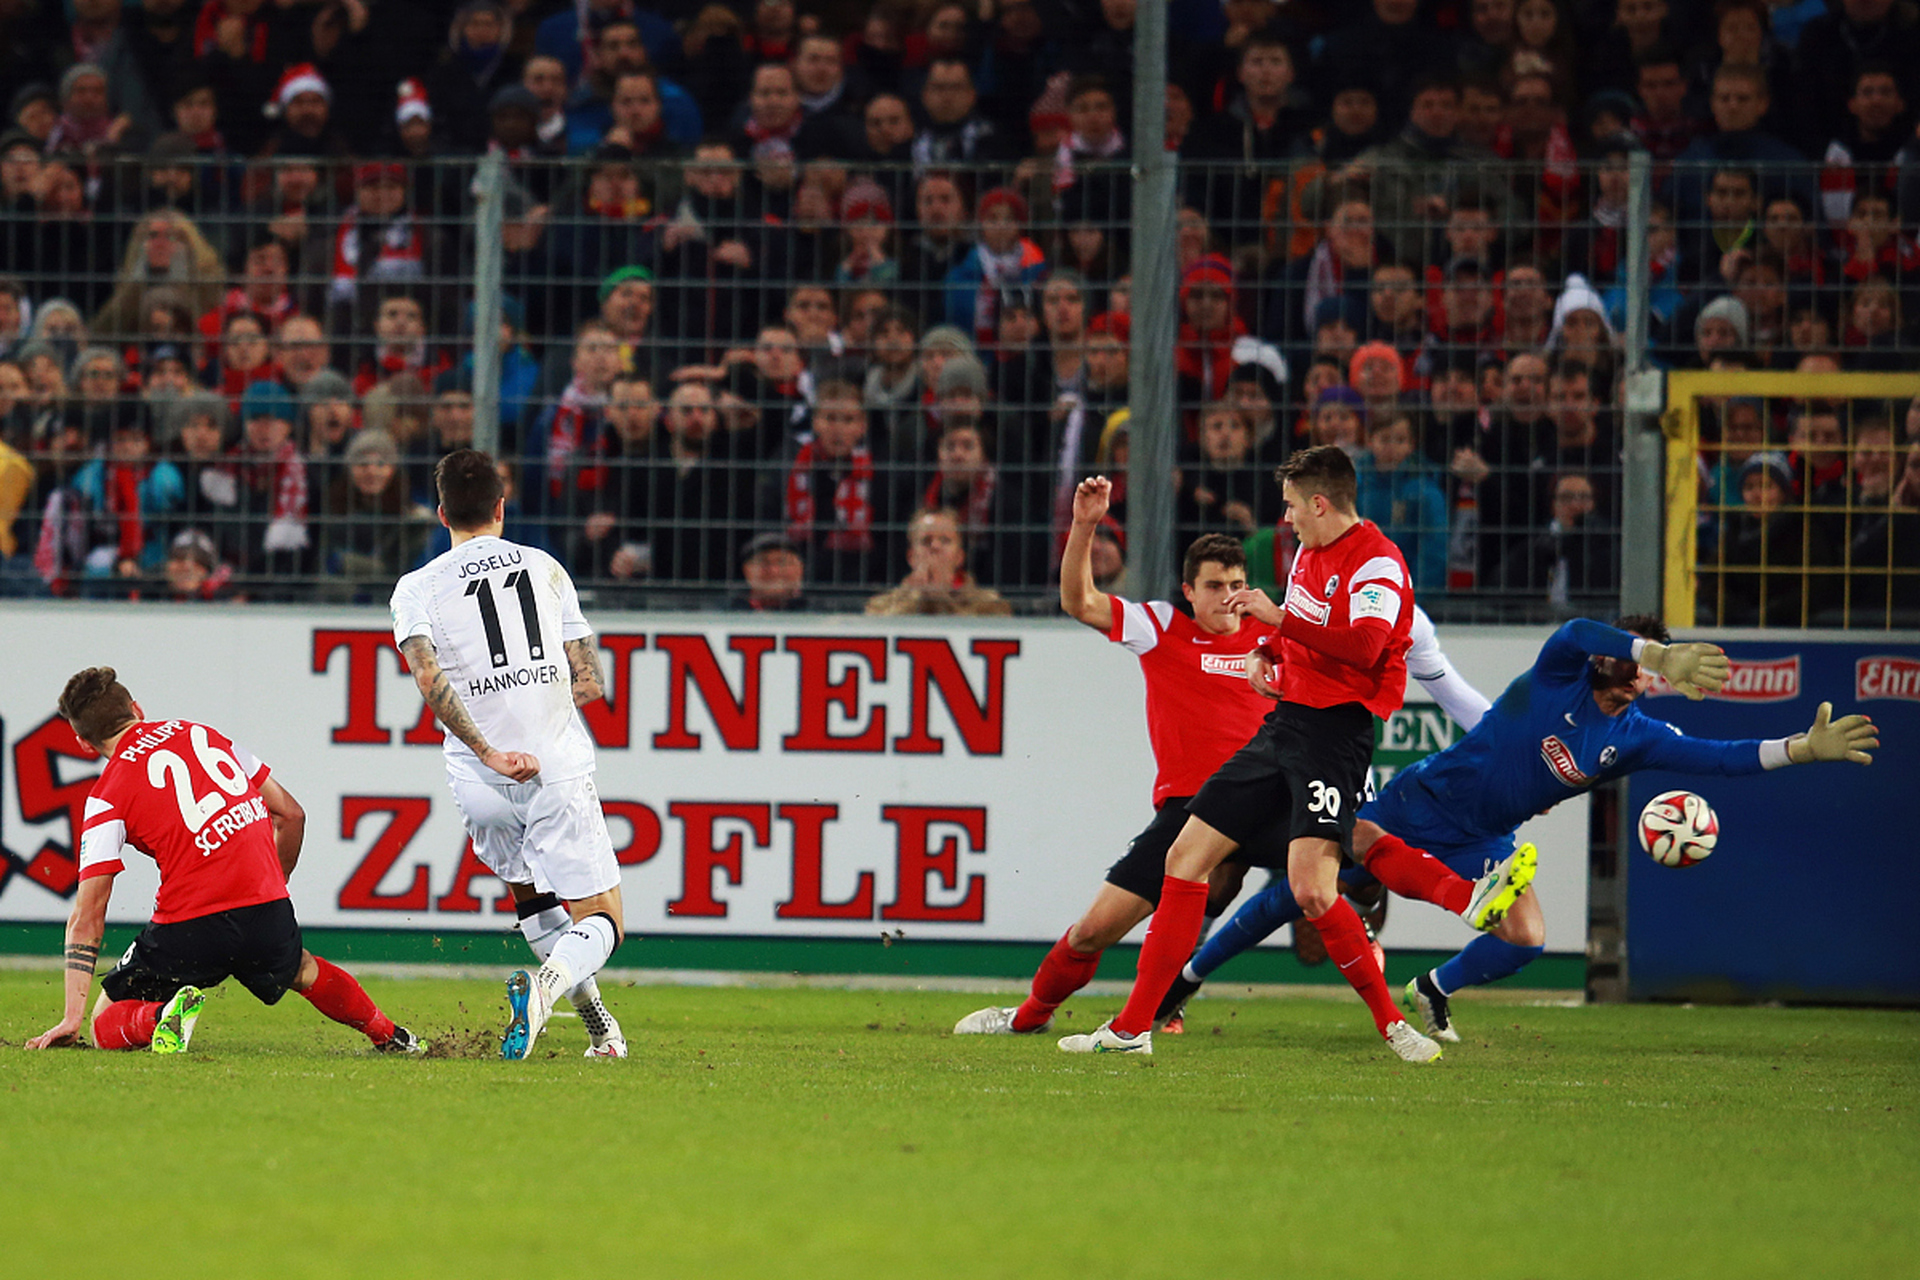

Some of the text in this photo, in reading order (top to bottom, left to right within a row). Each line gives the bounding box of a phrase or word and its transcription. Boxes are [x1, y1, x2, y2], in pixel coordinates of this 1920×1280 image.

[458, 550, 523, 579] JOSELU
[463, 568, 545, 669] 11
[468, 664, 560, 697] HANNOVER
[1204, 656, 1247, 670] Ehrm
[119, 720, 184, 762] PHILIPP
[1375, 709, 1454, 752] EN
[147, 724, 249, 834] 26
[1543, 740, 1584, 781] Ehrma
[1308, 780, 1341, 818] 30
[195, 827, 222, 857] SC
